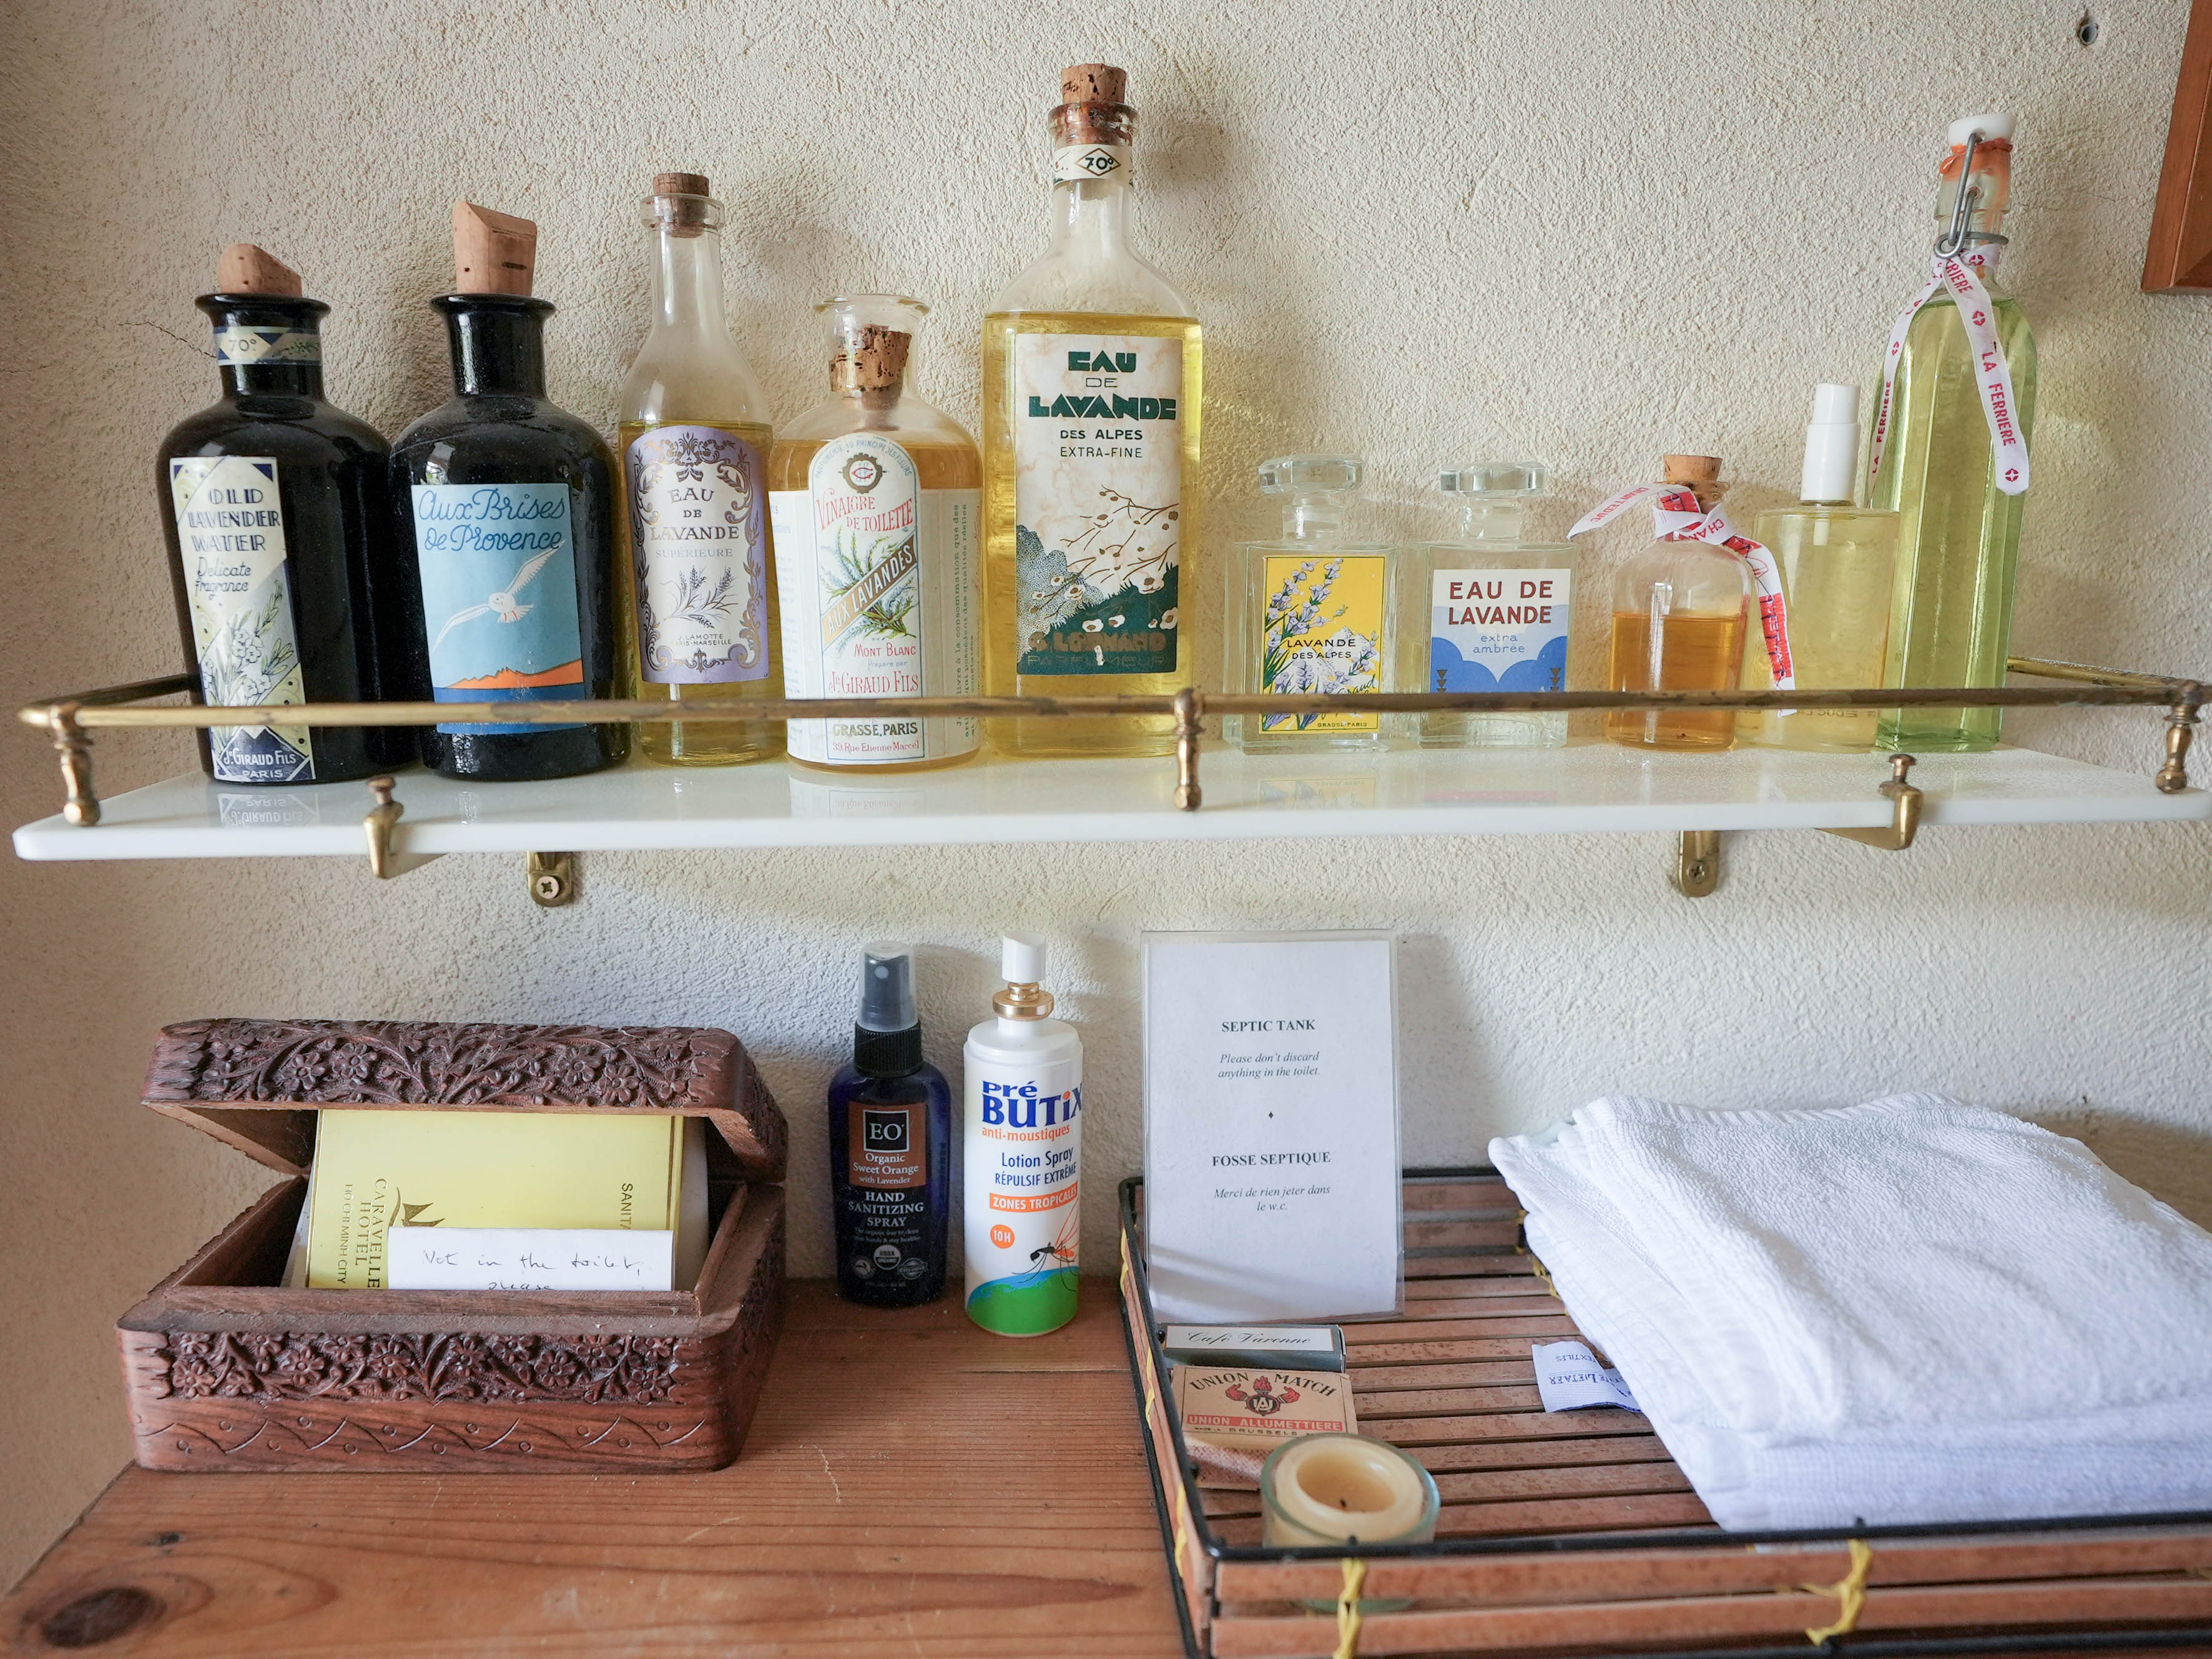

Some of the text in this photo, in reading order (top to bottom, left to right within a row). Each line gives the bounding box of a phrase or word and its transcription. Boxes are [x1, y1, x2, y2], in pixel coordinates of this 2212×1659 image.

[1068, 350, 1136, 373] EAU
[1086, 378, 1118, 388] DE
[1981, 352, 2017, 446] LA FERRIERE
[1029, 393, 1176, 421] LAVANDE
[1060, 429, 1143, 440] DES ALPES
[1872, 380, 1891, 474] LA FERRIERE
[1060, 446, 1143, 458] EXTRA-FINE
[667, 488, 715, 503] EAU
[419, 488, 565, 521] Aux Brises
[816, 488, 876, 531] VINAIGRE
[188, 511, 280, 528] LAVENDER
[684, 510, 702, 518] DE
[847, 497, 913, 532] DE TOILETTE
[424, 524, 562, 551] de Provence
[649, 525, 740, 541] LAVANDE
[191, 534, 267, 552] WATER
[197, 556, 251, 576] Delicate
[827, 599, 851, 635] AUX
[851, 544, 913, 613] LAVANDES
[1450, 581, 1553, 599] EAU DE
[1448, 606, 1552, 625] LAVANDE
[1287, 639, 1356, 648] LAVANDE
[1481, 633, 1518, 642] extra
[1315, 651, 1352, 659] ALPES
[1473, 644, 1525, 654] ambrée
[892, 740, 920, 751] Marcel
[242, 770, 283, 778] PARIS
[1221, 1019, 1315, 1032] SEPTIC TANK
[1219, 1051, 1320, 1063] Please don't discard
[1218, 1065, 1319, 1080] anything in the toilet.
[869, 1123, 903, 1141] EO
[865, 1152, 906, 1165] Organic
[1001, 1146, 1074, 1168] Lotion Spray
[1212, 1151, 1331, 1166] FOSSE SEPTIQUE
[853, 1162, 919, 1175] Sweet Orange
[858, 1176, 911, 1184] with Lavender
[995, 1171, 1041, 1186] RÉPULSIF
[865, 1191, 905, 1203] HAND
[993, 1186, 1077, 1209] ZONES TROPICALES
[1214, 1185, 1330, 1198] Merci de rien jeter dans
[848, 1200, 925, 1215] SANITIZING
[1257, 1201, 1265, 1211] le
[867, 1217, 907, 1228] SPRAY
[337, 1184, 353, 1284] HO CHI MINH CITY
[355, 1202, 371, 1266] HOTEL
[366, 1178, 387, 1288] CARAVELLE
[477, 1254, 504, 1266] in
[519, 1252, 558, 1269] the
[1188, 1331, 1232, 1345] Café
[1190, 1372, 1337, 1397] UNION MATCH
[1188, 1415, 1341, 1430] UNION ALLUMETTIERE
